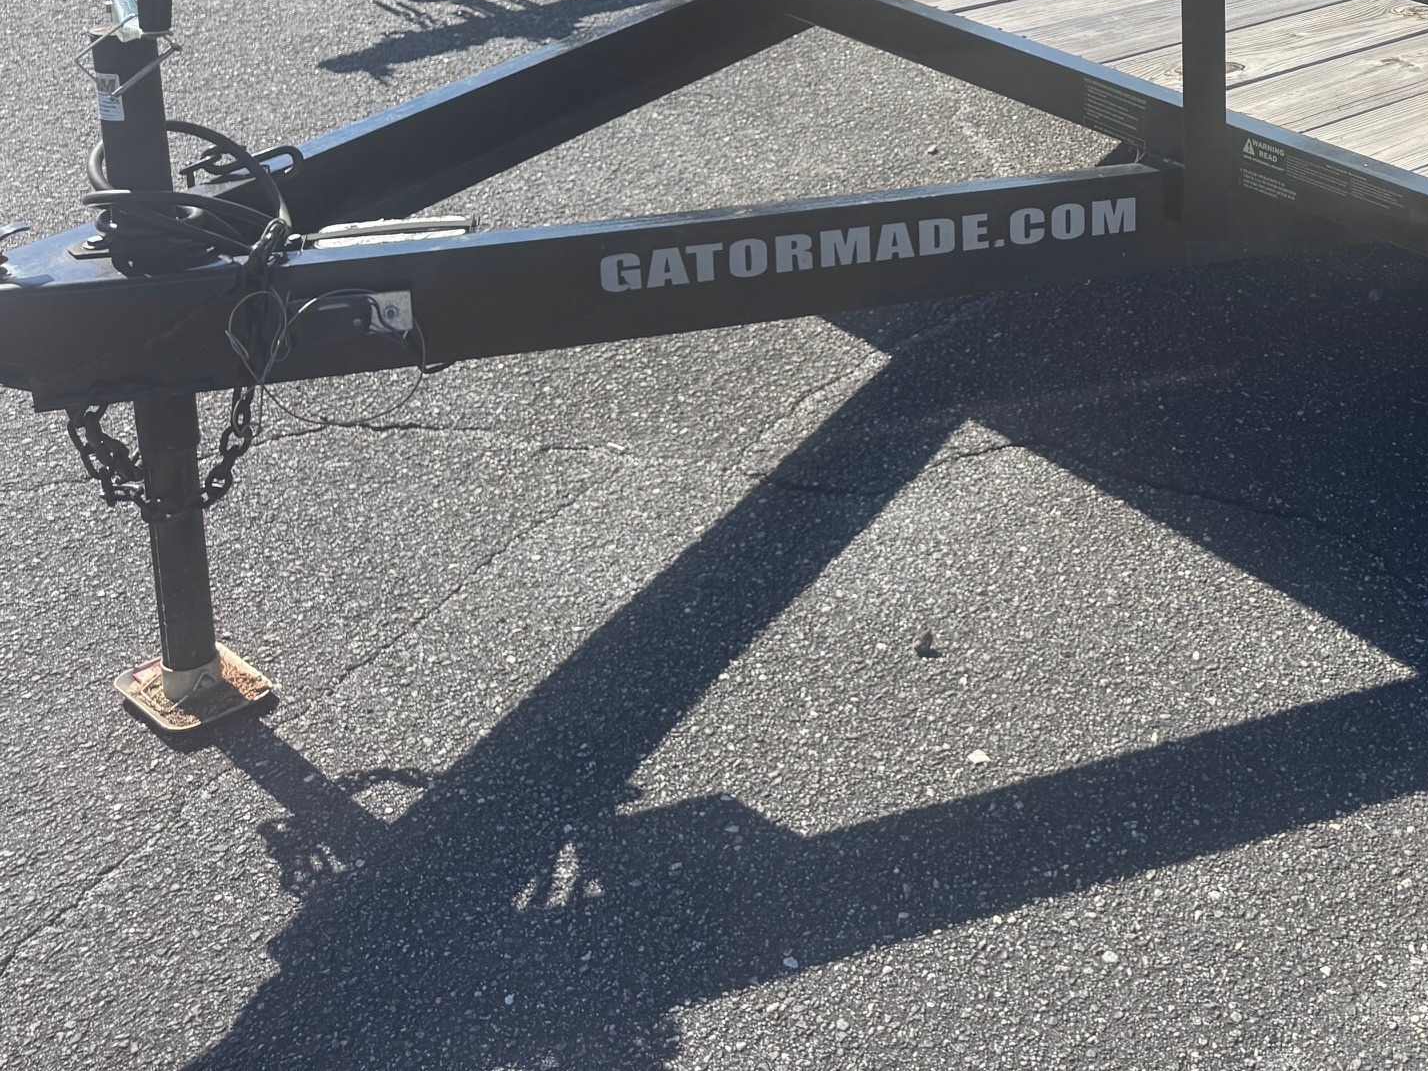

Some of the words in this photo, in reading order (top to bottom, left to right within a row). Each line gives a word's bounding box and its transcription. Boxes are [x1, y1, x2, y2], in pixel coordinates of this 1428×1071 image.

[1252, 139, 1285, 157] WARNING
[1259, 151, 1278, 163] READ
[599, 196, 1137, 293] GATORMADE.COM
